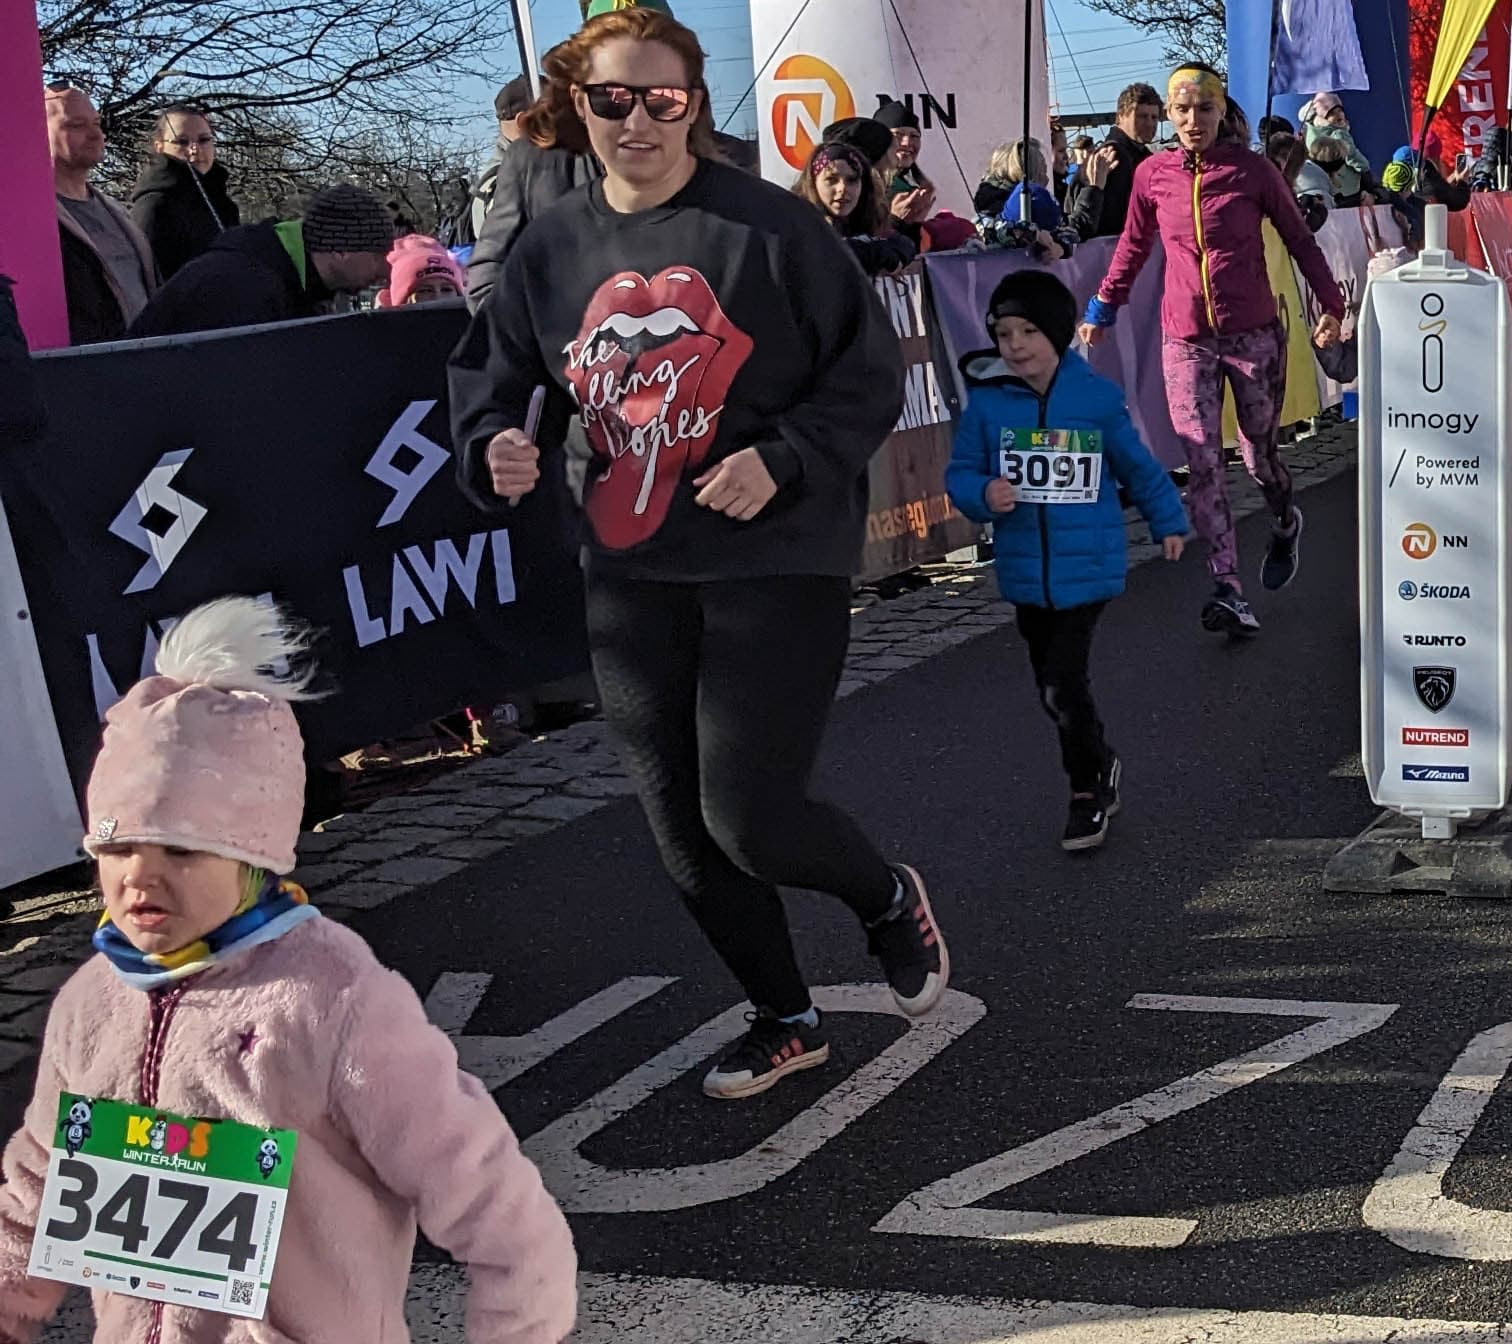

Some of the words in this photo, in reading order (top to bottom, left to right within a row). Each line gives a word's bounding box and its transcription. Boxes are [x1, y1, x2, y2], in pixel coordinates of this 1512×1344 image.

[1387, 406, 1479, 434] innogy
[1416, 455, 1480, 469] Powered
[1004, 453, 1092, 488] 3091
[1416, 472, 1435, 488] by
[1440, 473, 1479, 486] MVM
[1443, 535, 1468, 548] NN
[343, 528, 517, 648] LAWI
[1420, 582, 1471, 599] ŠKODA
[1414, 635, 1466, 647] RUNTO
[1405, 731, 1466, 743] NUTREND
[45, 1158, 259, 1272] 3474
